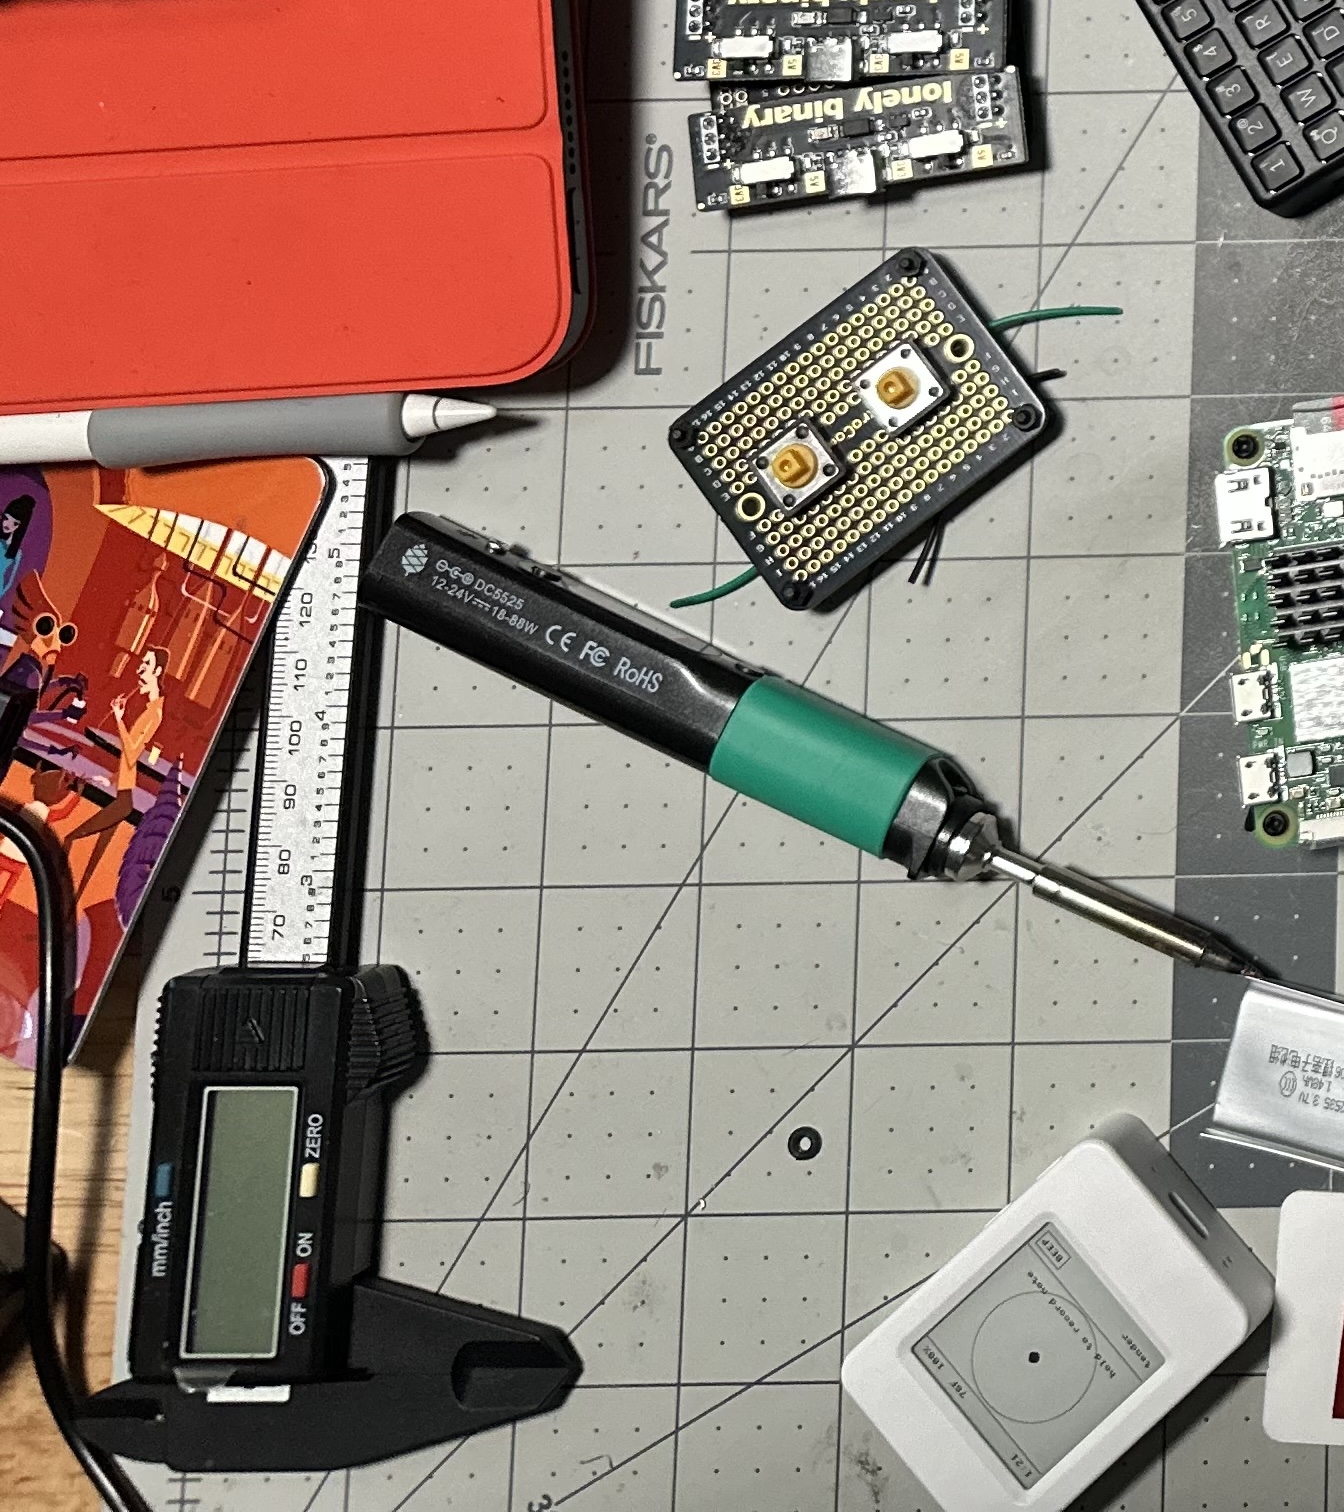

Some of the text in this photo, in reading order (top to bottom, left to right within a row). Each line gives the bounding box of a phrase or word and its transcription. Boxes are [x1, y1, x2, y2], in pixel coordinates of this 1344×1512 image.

[741, 80, 953, 129] lonely binary
[298, 591, 314, 628] 120
[474, 579, 525, 610] DC5525
[292, 658, 308, 691] 110
[545, 624, 664, 693] CE RoHS
[287, 719, 303, 756] 100
[282, 783, 298, 810] 90
[277, 848, 293, 877] 80
[271, 913, 287, 942] 70
[305, 1113, 323, 1159] ZERO
[151, 1201, 173, 1279] mm/inch
[297, 1232, 313, 1258] ON
[289, 1303, 307, 1336] OFF
[1047, 1297, 1081, 1334] record
